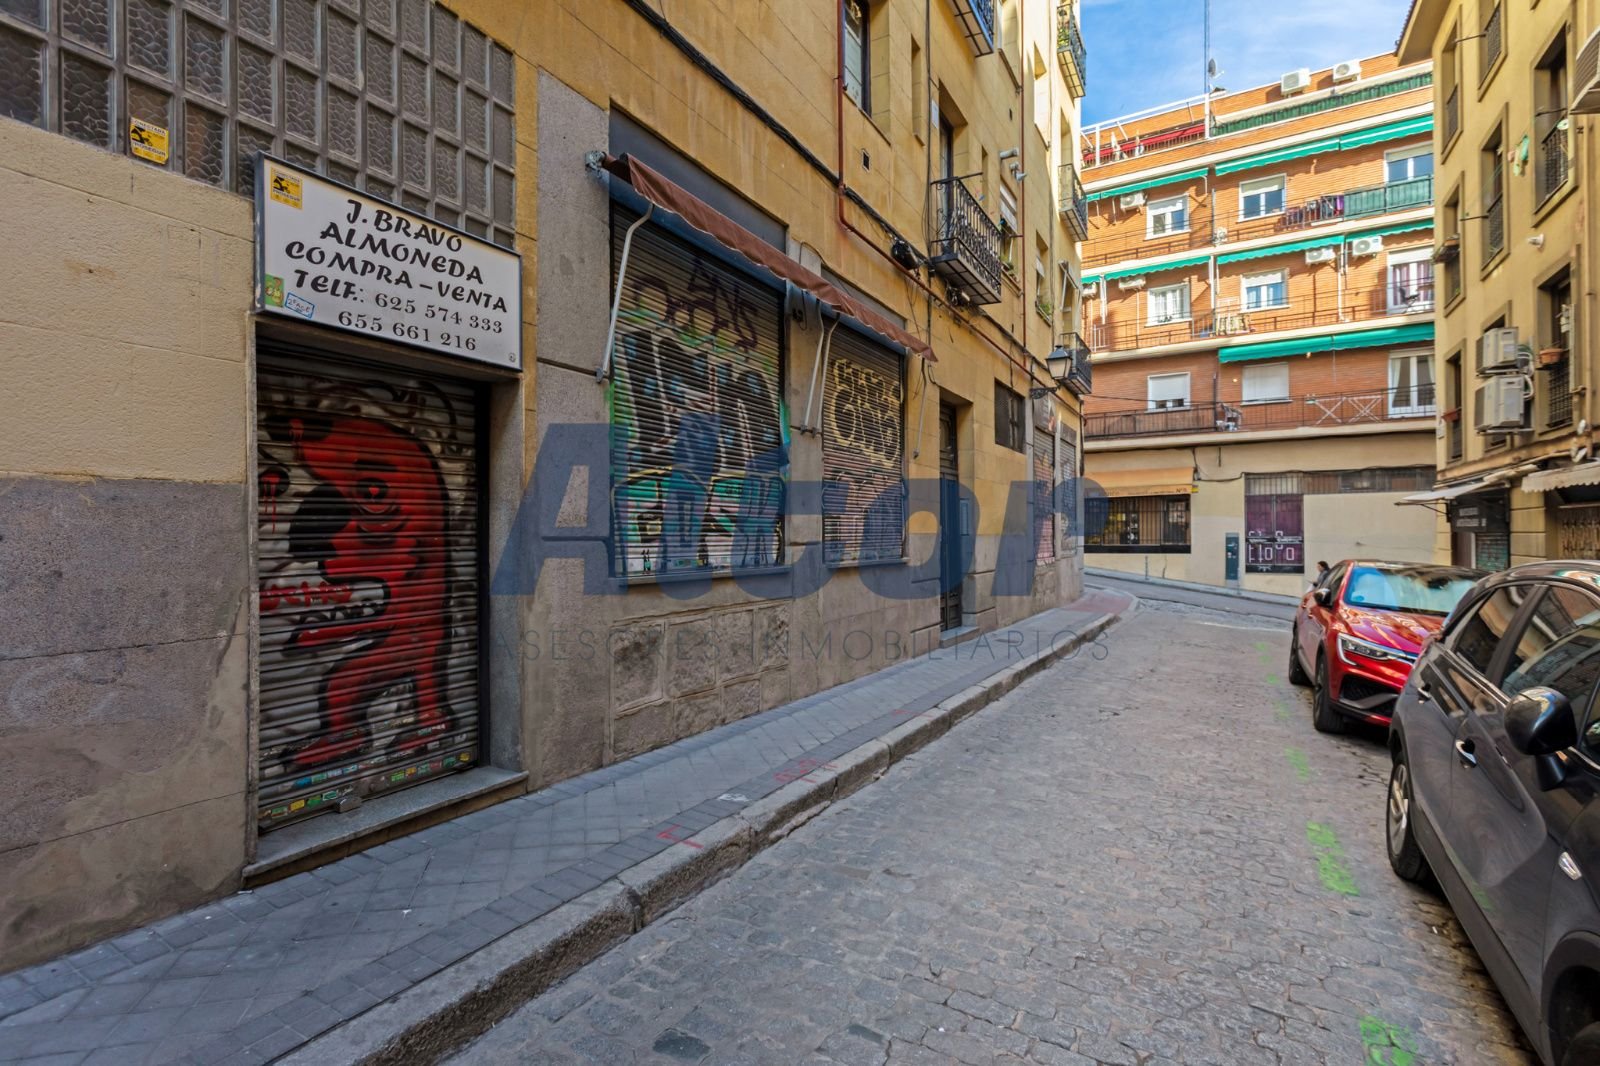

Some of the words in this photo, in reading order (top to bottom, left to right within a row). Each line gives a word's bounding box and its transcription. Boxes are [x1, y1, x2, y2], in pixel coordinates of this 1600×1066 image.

[346, 199, 367, 224] J.
[374, 209, 462, 252] BRAVO
[320, 222, 483, 284] ALMONEDA
[338, 310, 383, 332] 655
[392, 322, 431, 342] 661
[440, 332, 476, 351] 216
[375, 292, 416, 314] 625
[425, 304, 463, 325] 574
[469, 315, 503, 333] 333
